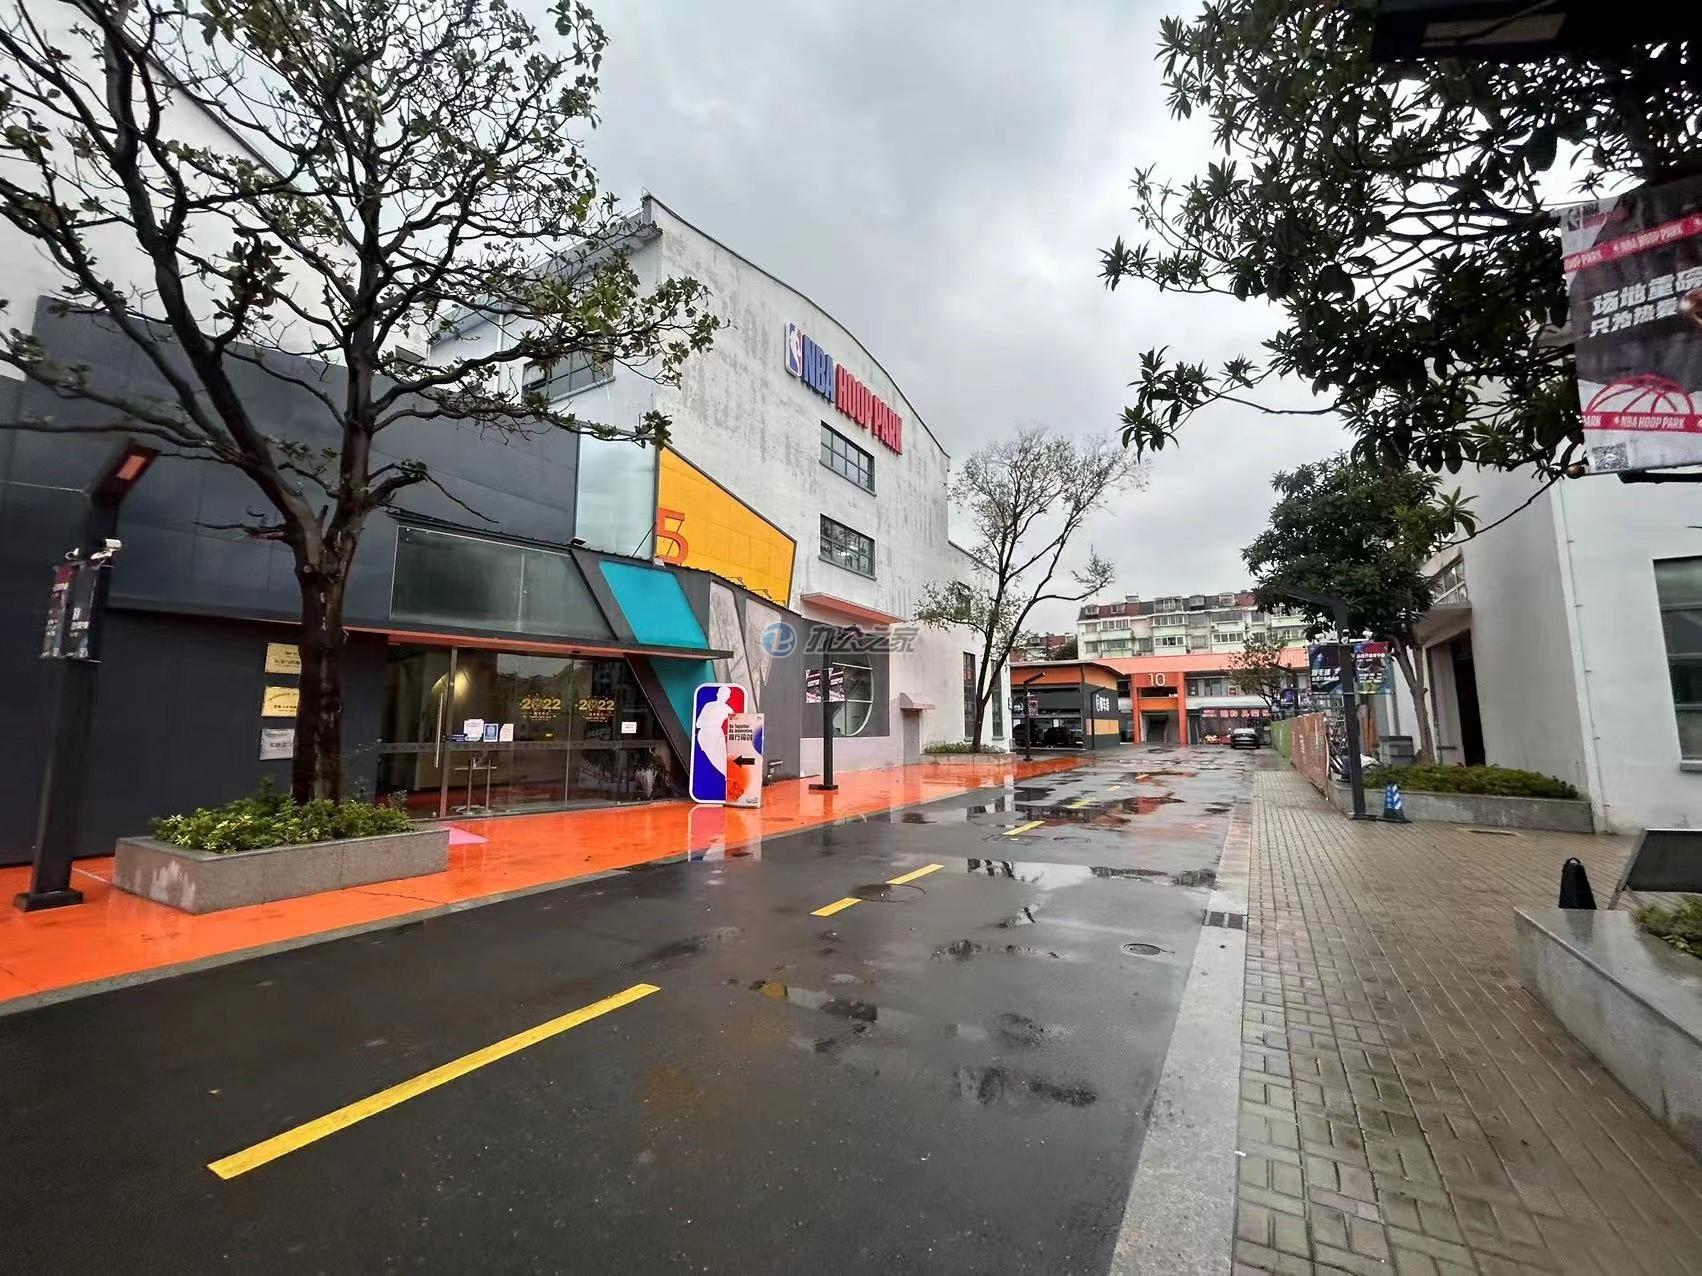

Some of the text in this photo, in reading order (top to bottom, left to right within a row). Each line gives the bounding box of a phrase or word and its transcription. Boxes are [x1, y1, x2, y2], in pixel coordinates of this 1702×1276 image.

[801, 333, 902, 455] NBA HOOP PARK
[1620, 415, 1686, 430] NBA HOOP PARK
[656, 507, 689, 565] 5
[1147, 672, 1167, 687] 10
